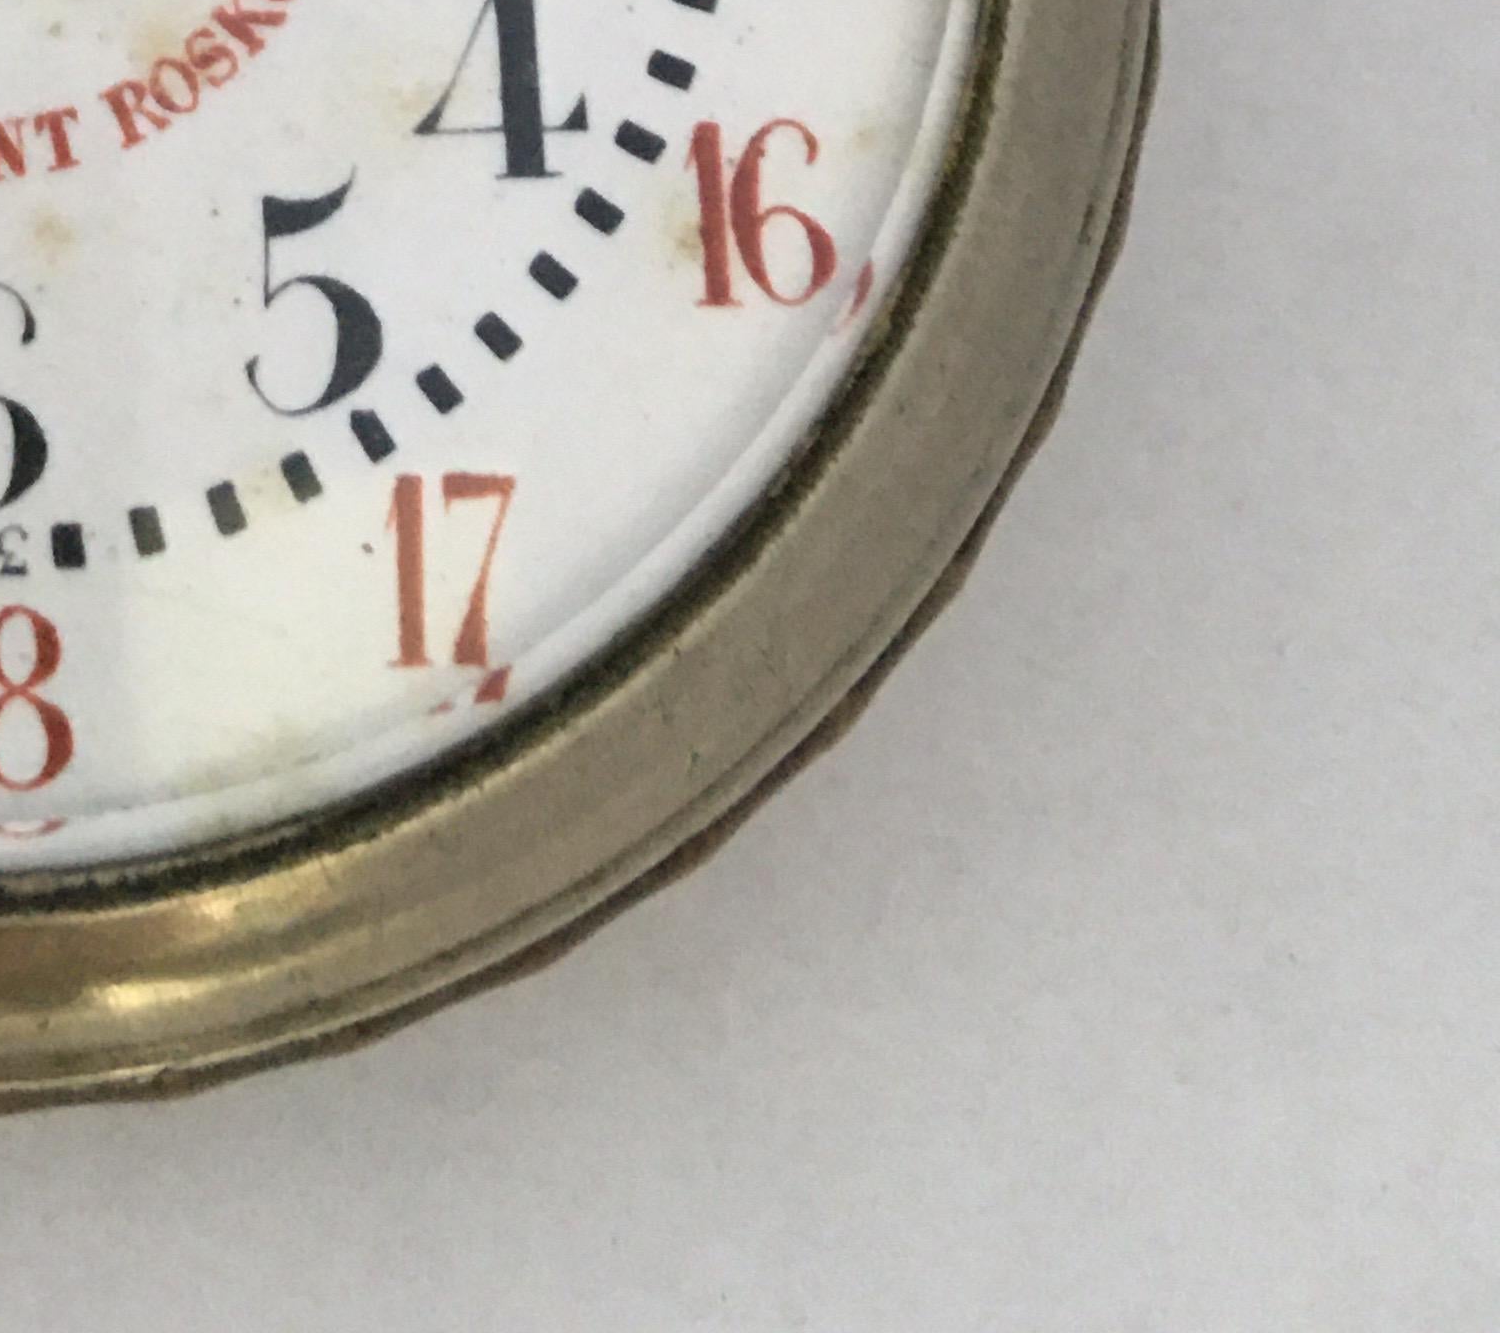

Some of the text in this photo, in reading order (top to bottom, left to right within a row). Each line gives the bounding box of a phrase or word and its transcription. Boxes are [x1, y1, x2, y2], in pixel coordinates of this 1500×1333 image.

[244, 165, 385, 417] 5
[683, 117, 840, 310] 16
[384, 471, 518, 669] 17
